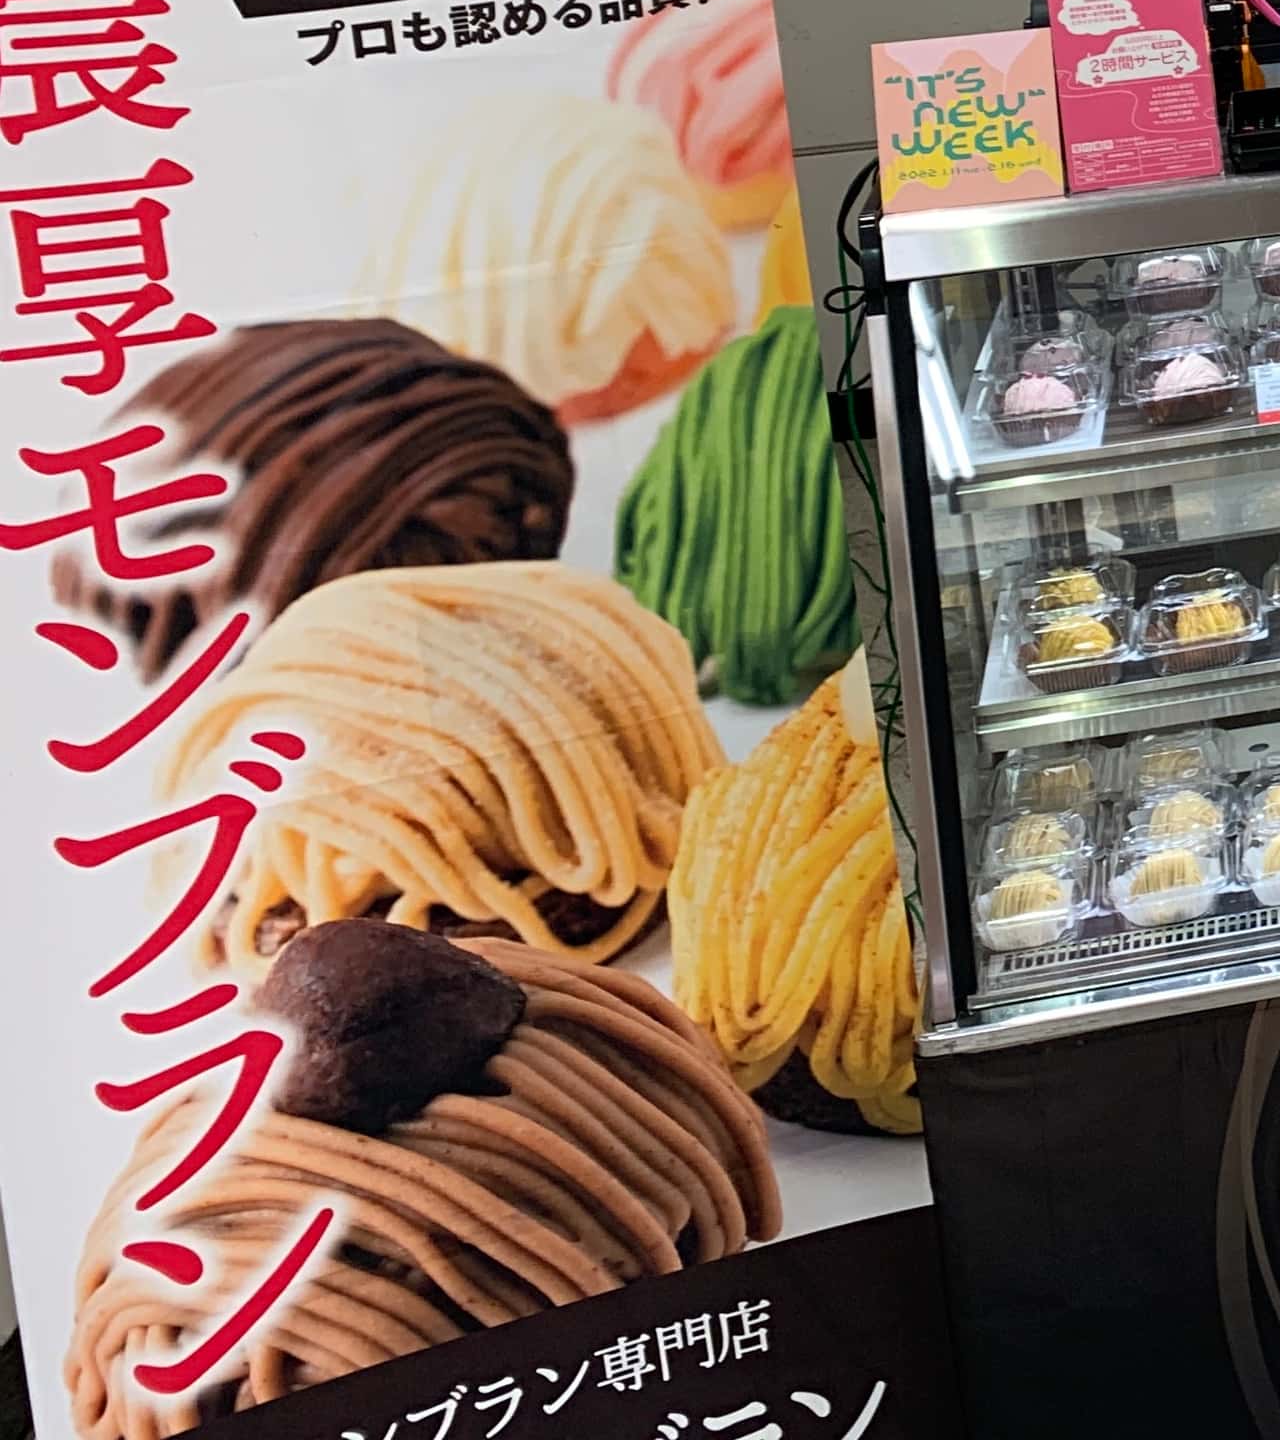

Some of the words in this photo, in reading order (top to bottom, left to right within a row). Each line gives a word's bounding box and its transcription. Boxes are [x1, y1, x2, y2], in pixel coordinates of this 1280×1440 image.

[1089, 49, 1192, 74] 2時間サービス
[891, 120, 1035, 160] WEEK
